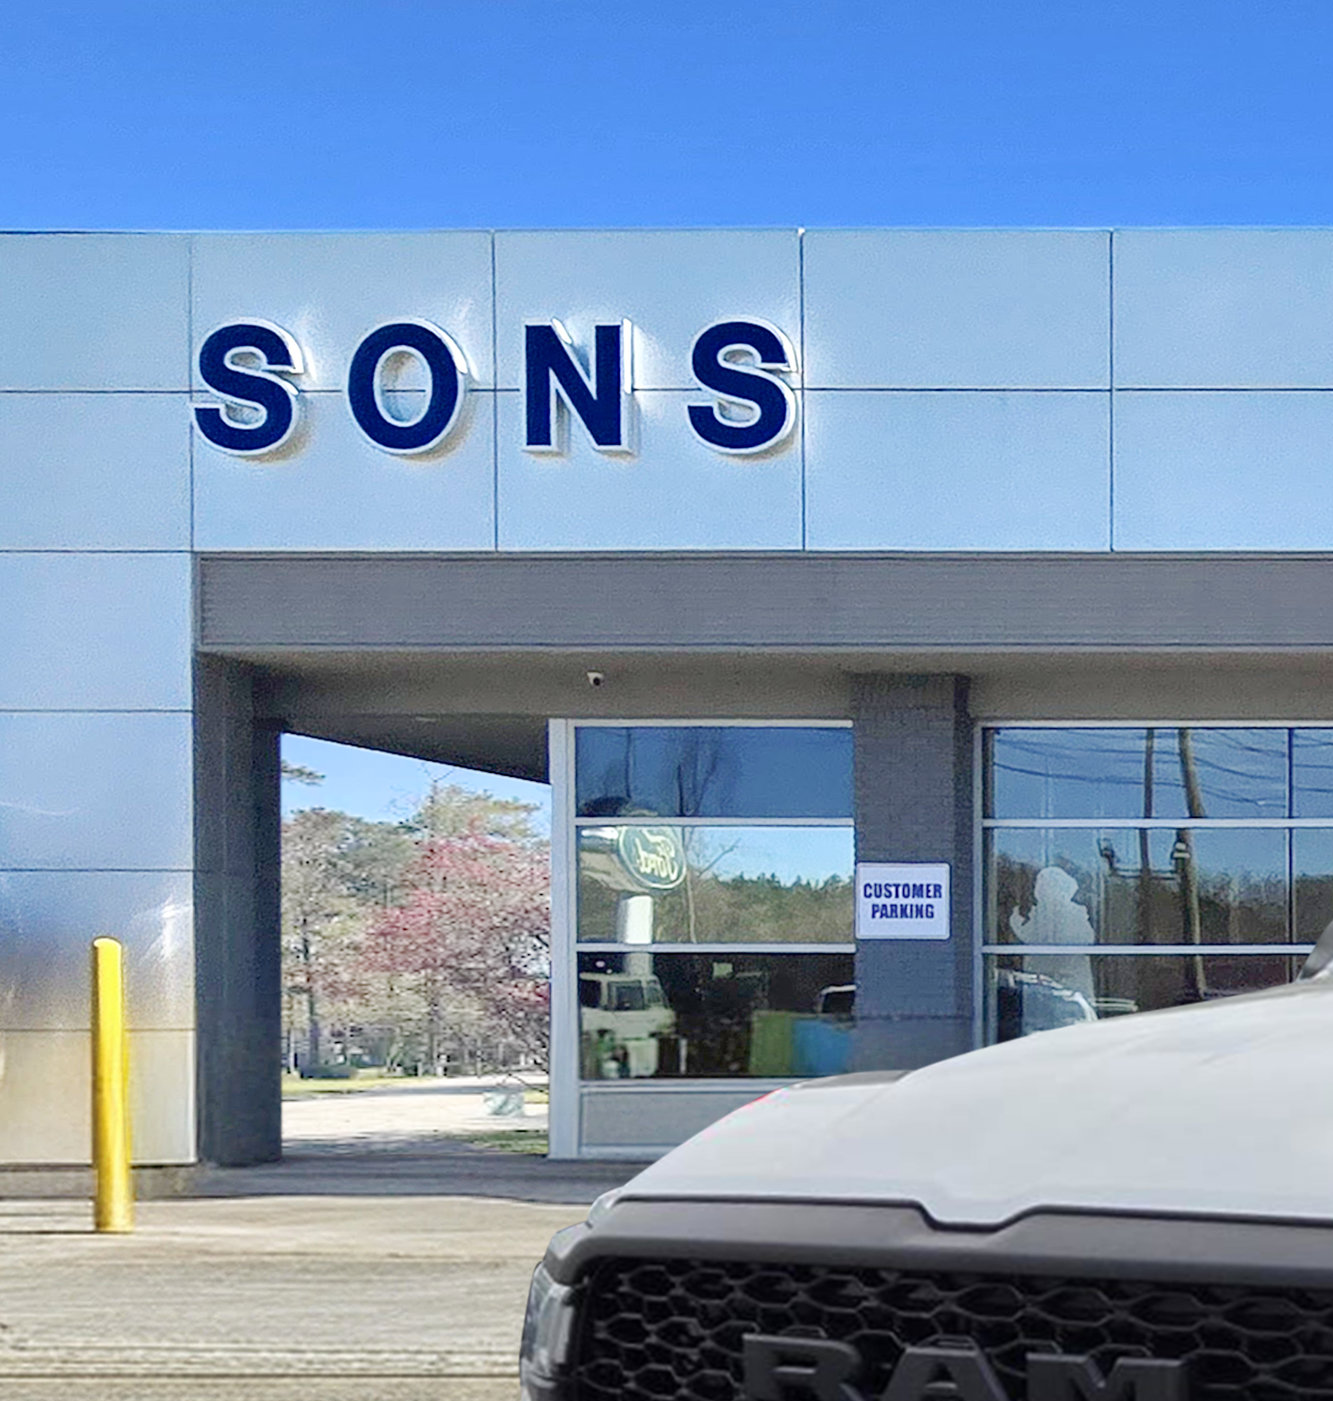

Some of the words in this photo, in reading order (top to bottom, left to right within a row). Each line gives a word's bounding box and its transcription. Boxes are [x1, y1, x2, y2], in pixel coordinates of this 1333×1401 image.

[193, 318, 798, 454] SONS
[863, 882, 943, 899] CUSTOMER
[871, 903, 935, 919] PARKING
